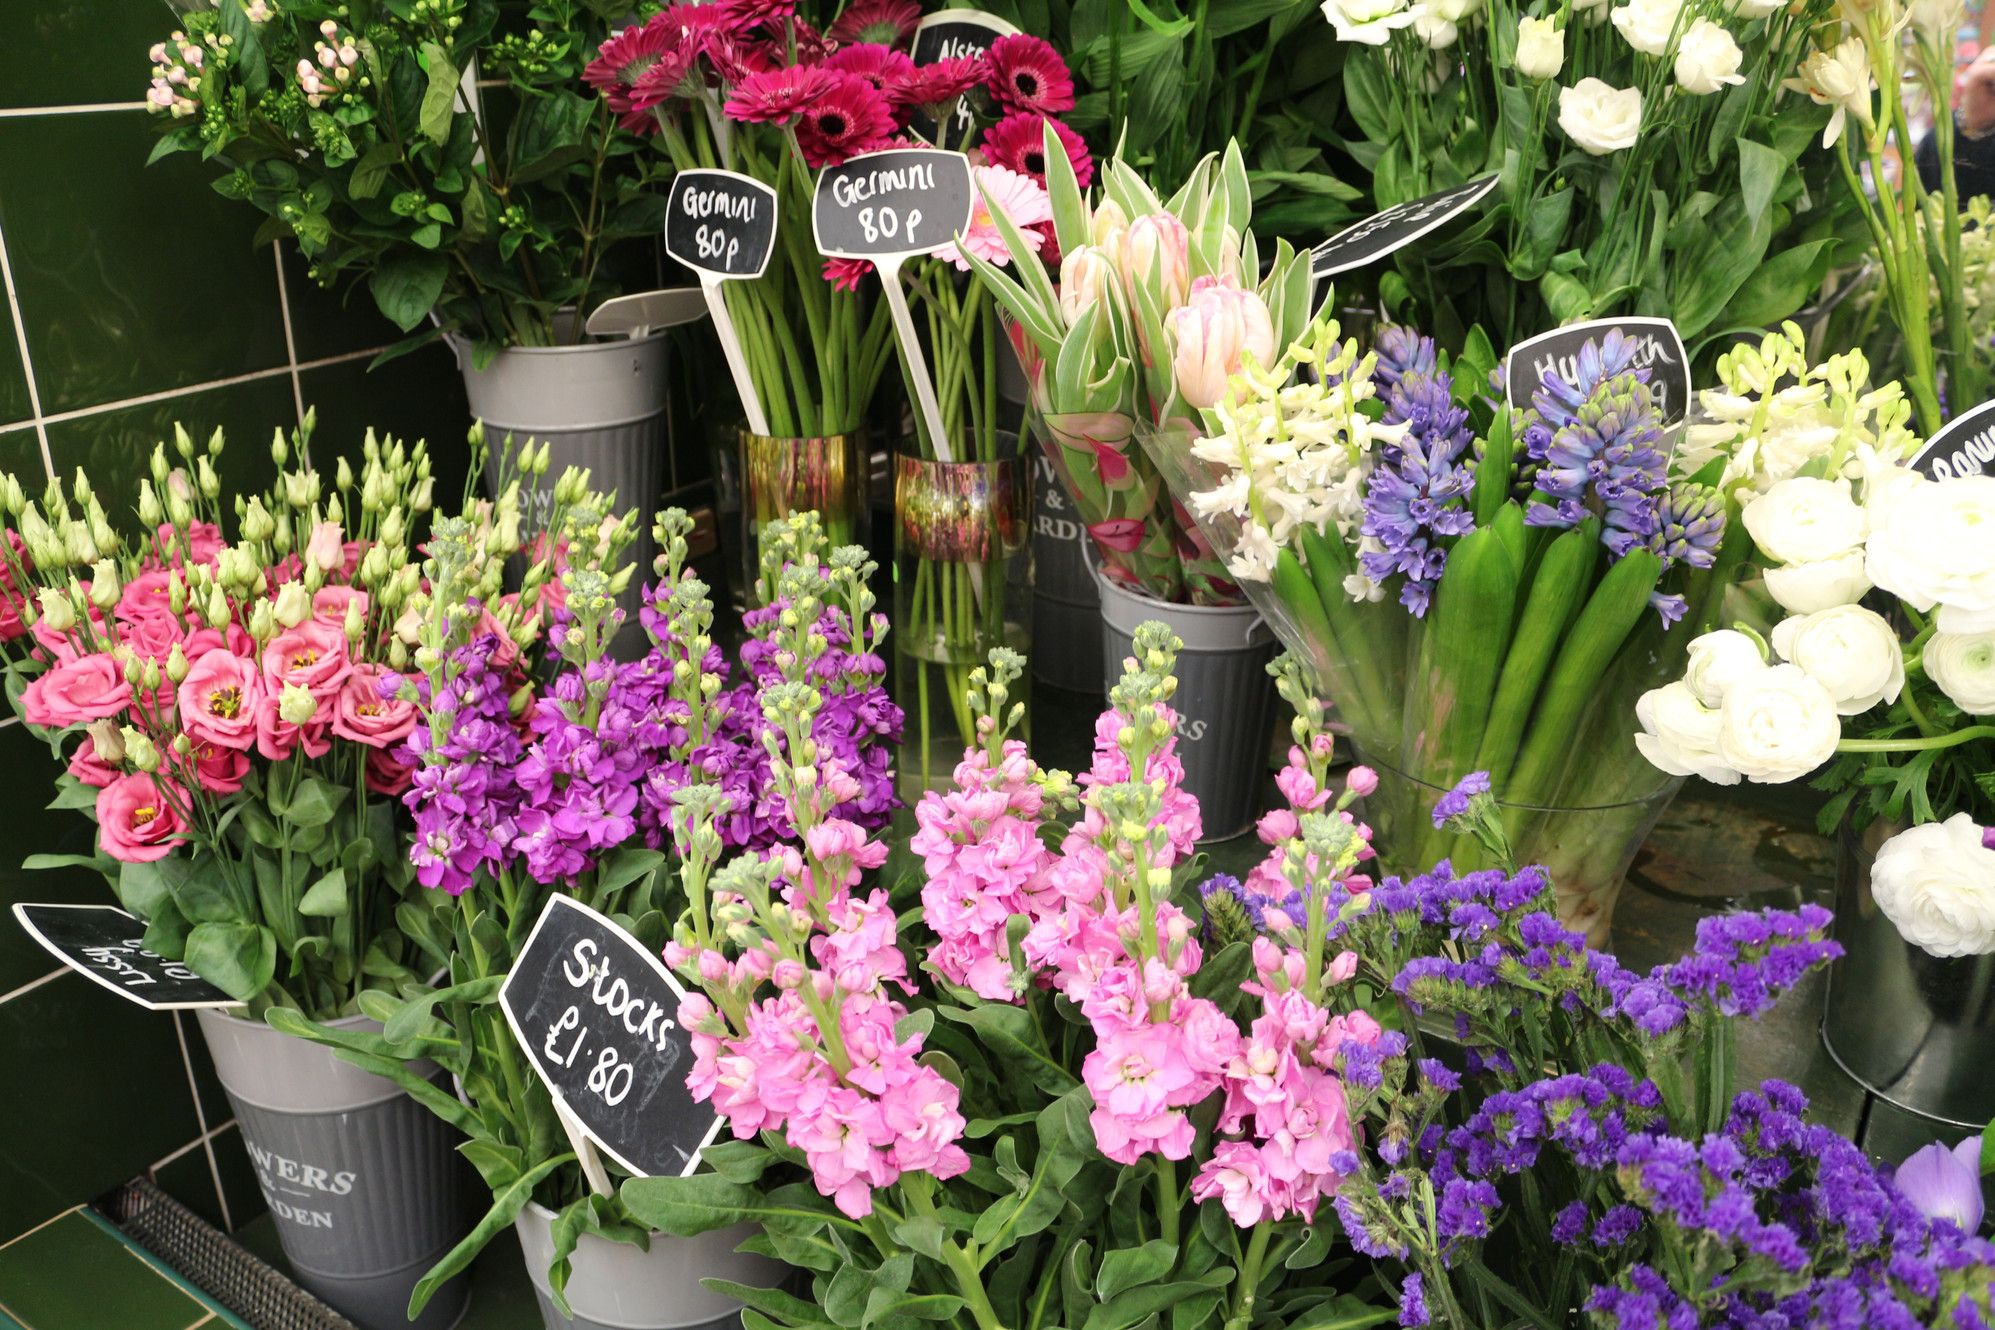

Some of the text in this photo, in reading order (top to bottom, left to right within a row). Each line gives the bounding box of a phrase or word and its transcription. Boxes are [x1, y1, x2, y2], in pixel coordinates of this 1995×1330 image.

[682, 186, 757, 223] Germini
[832, 162, 936, 208] Germini
[695, 224, 739, 271] 80p
[1045, 489, 1065, 510] &
[563, 938, 675, 1052] Stocks
[245, 1140, 357, 1196] WERS
